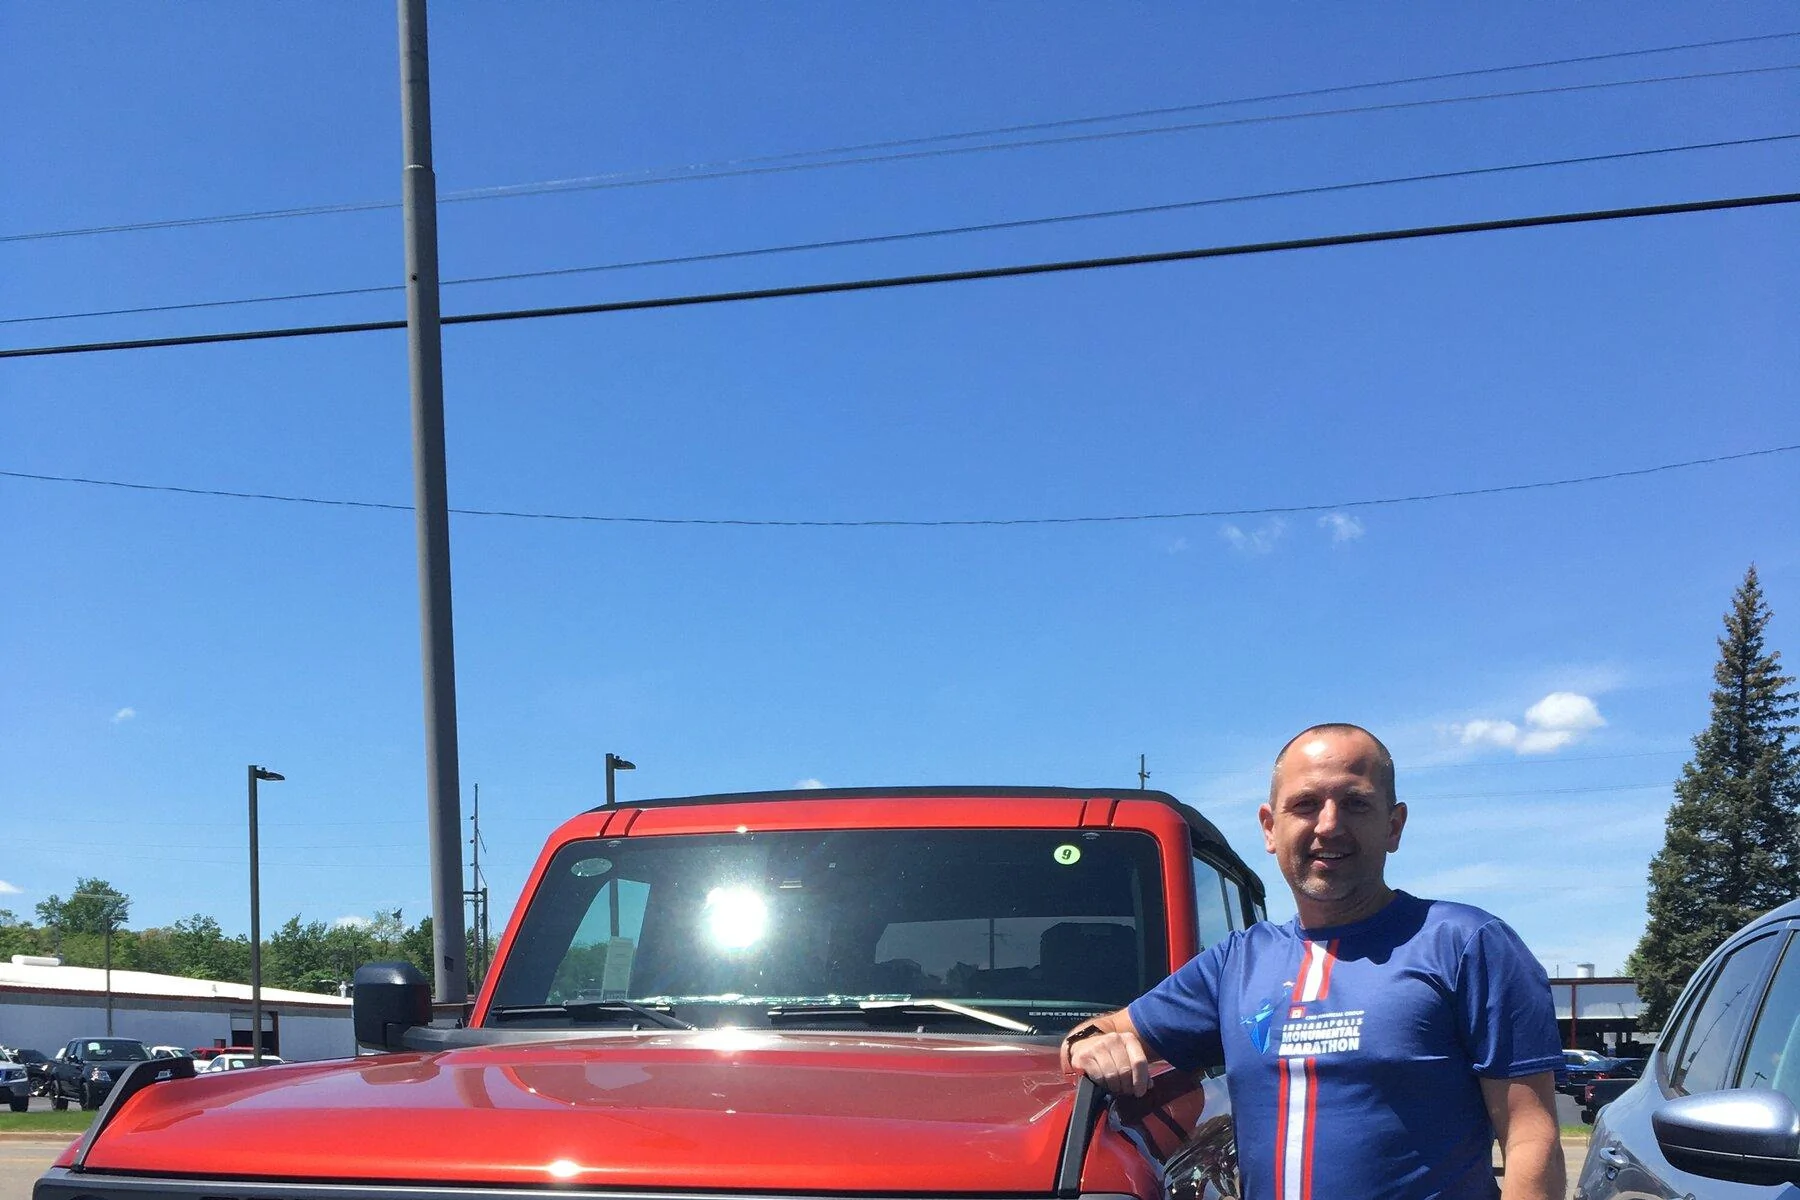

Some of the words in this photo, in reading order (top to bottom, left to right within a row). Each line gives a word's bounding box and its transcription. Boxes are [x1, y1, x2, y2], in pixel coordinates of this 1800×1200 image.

[1061, 848, 1072, 860] 9
[1283, 1018, 1363, 1031] INDIANAPOLIS
[1282, 1026, 1360, 1043] MONUMENTAL
[1279, 1037, 1360, 1055] MARATHON
